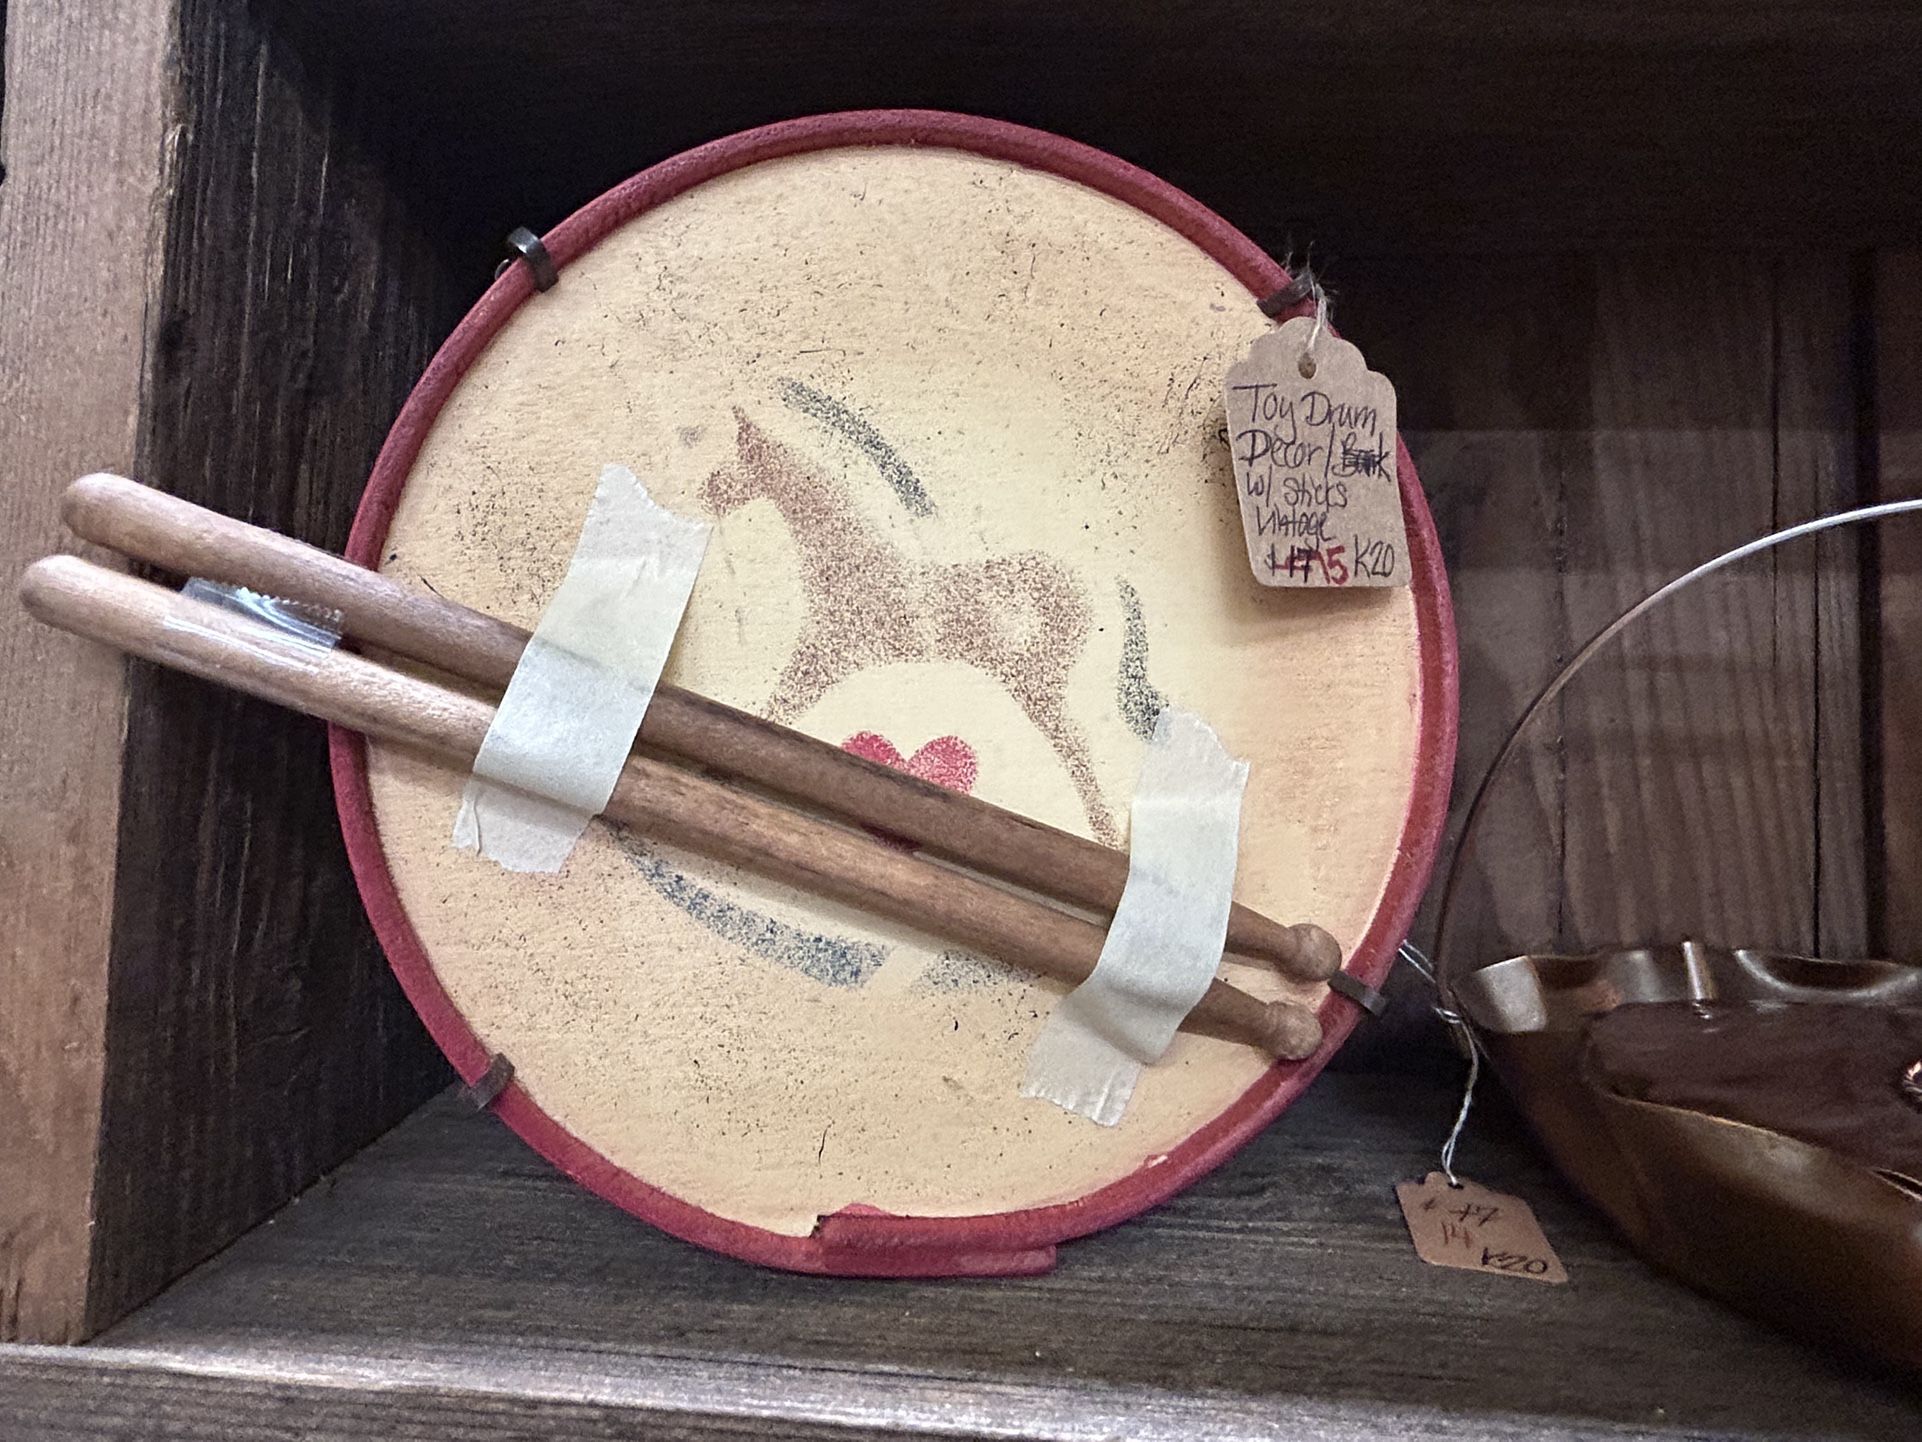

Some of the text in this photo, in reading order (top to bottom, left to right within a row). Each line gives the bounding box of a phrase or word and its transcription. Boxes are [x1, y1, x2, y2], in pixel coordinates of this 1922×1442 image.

[1232, 383, 1378, 438] Toy Drum
[1353, 534, 1395, 579] K20
